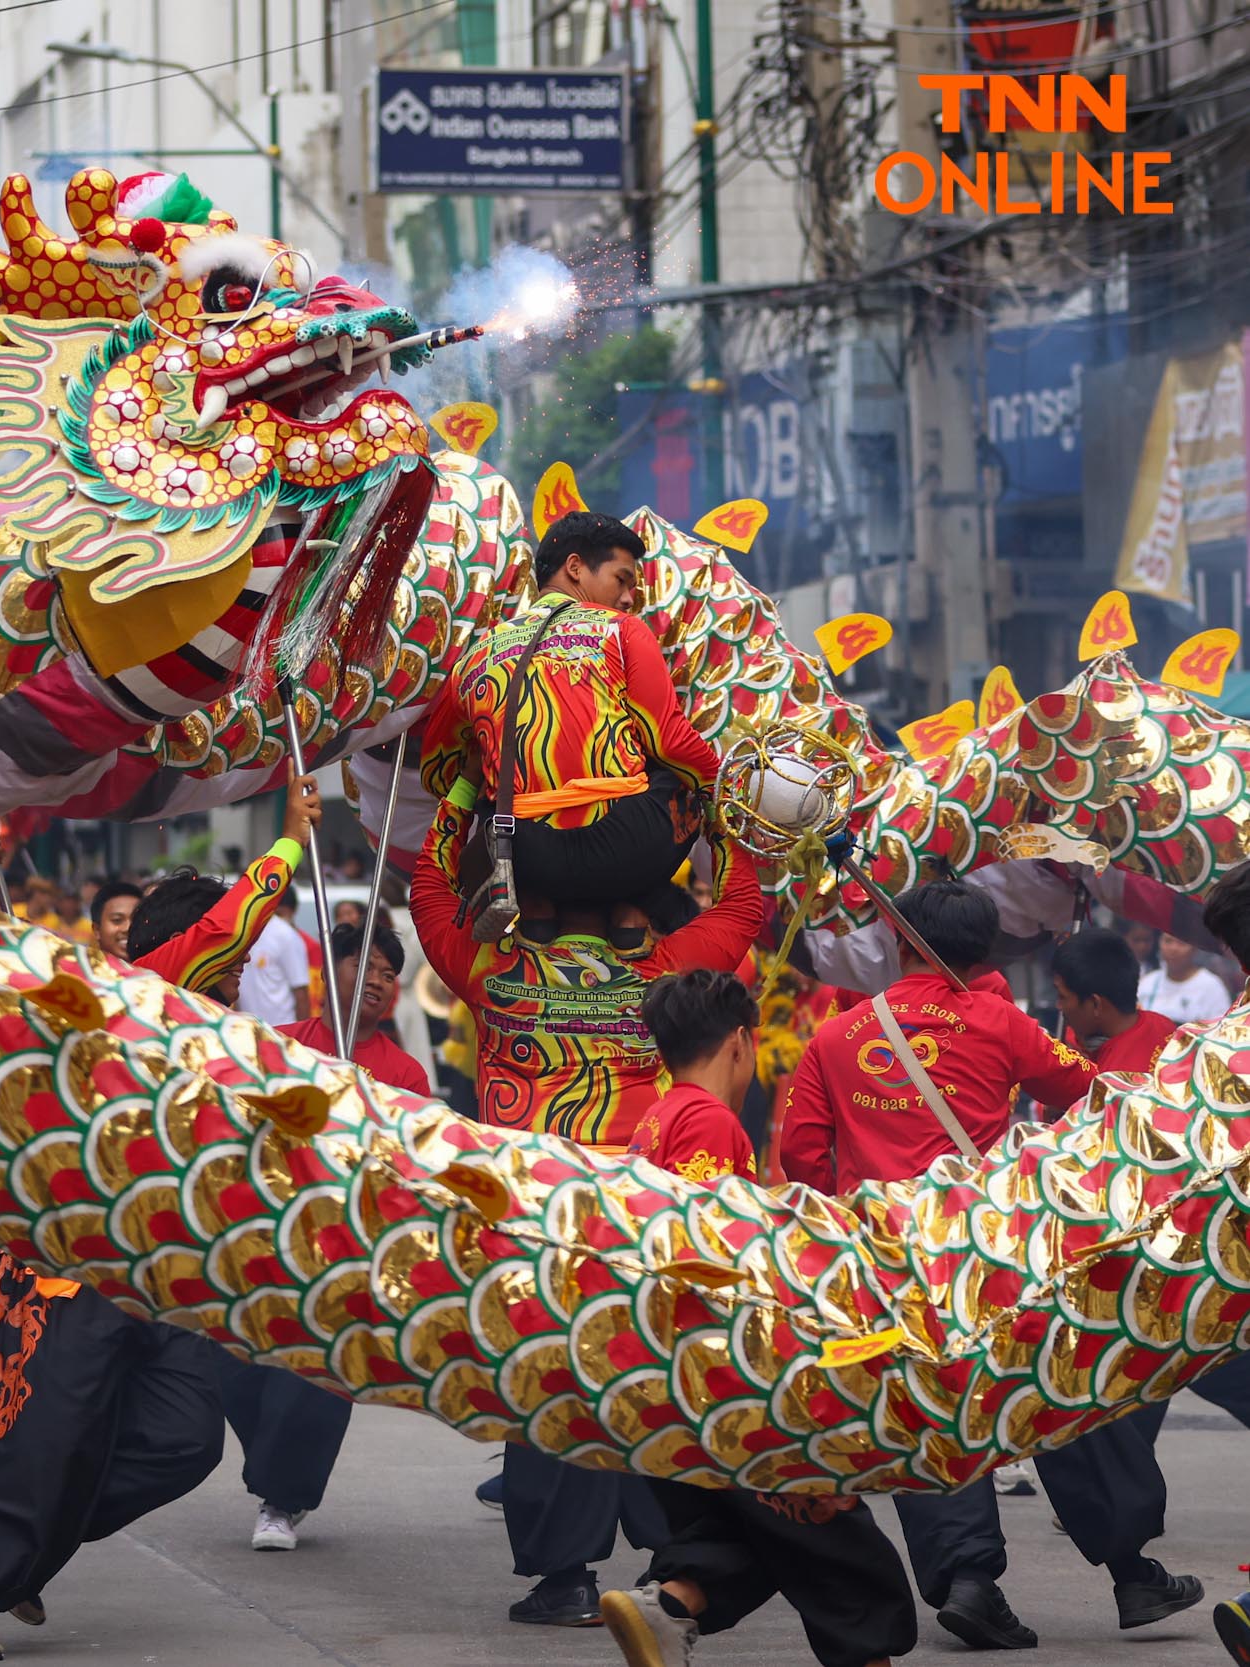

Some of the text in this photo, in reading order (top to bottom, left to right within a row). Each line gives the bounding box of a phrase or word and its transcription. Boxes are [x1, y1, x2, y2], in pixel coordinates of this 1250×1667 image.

[430, 114, 620, 139] Indian Overseas Bank
[466, 145, 529, 168] Bangkok
[845, 1003, 967, 1040] CHINSE SHOWS
[852, 1091, 877, 1109] 091
